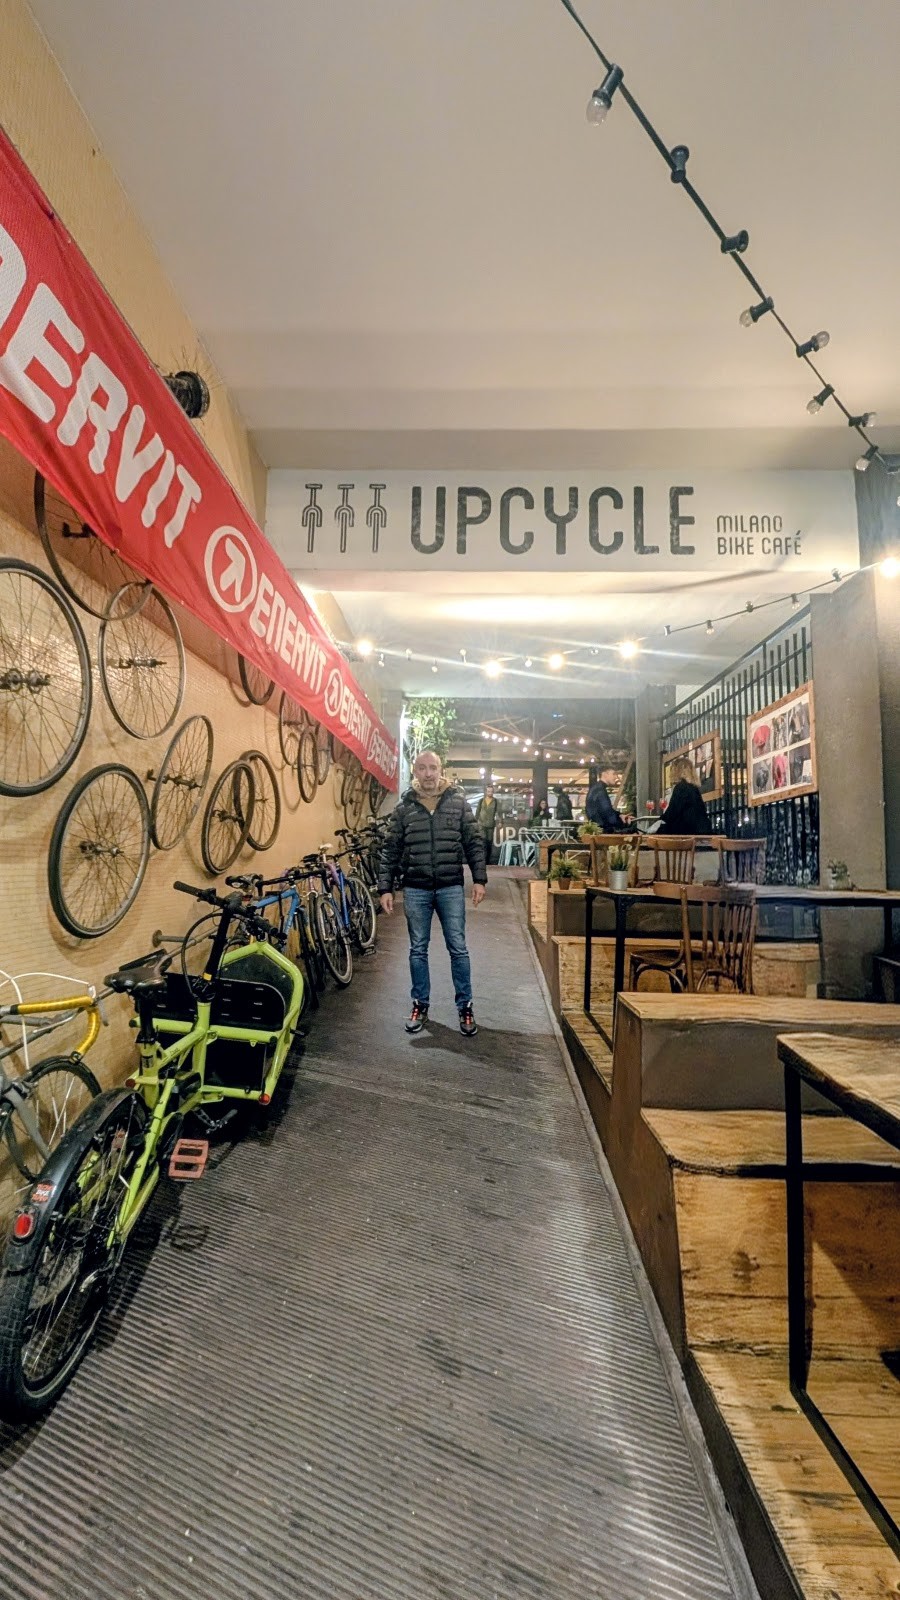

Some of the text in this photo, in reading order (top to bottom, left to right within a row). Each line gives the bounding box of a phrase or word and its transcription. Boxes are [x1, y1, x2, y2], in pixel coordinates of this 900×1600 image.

[411, 486, 694, 555] UPCYCLE
[717, 515, 783, 533] MILANO
[717, 530, 802, 555] BIKE CAFÉ
[249, 572, 327, 695] ENERVIT
